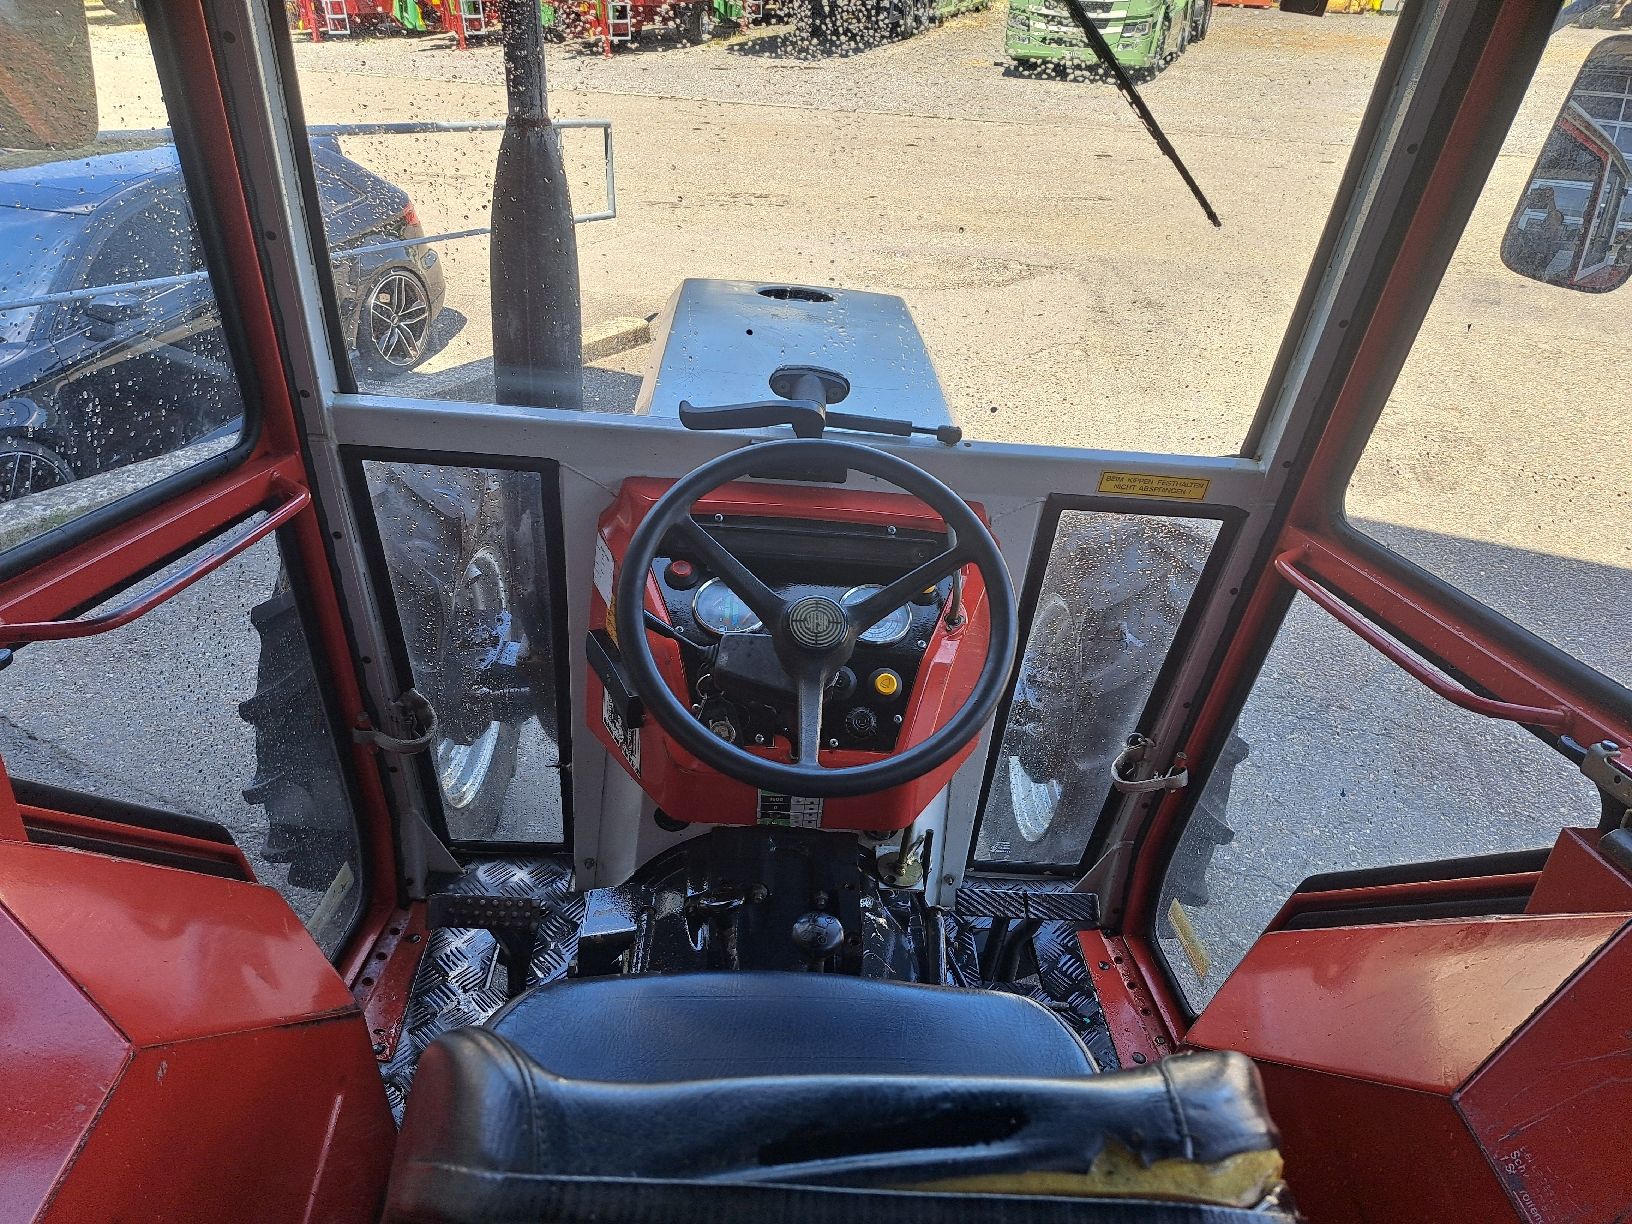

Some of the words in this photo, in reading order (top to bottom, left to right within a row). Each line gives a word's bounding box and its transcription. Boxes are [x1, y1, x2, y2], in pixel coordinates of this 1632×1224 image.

[1113, 483, 1136, 491] NICHT
[1127, 477, 1154, 485] KIPPEN
[1157, 479, 1205, 489] FESTHALTEN
[805, 611, 829, 632] STEYR
